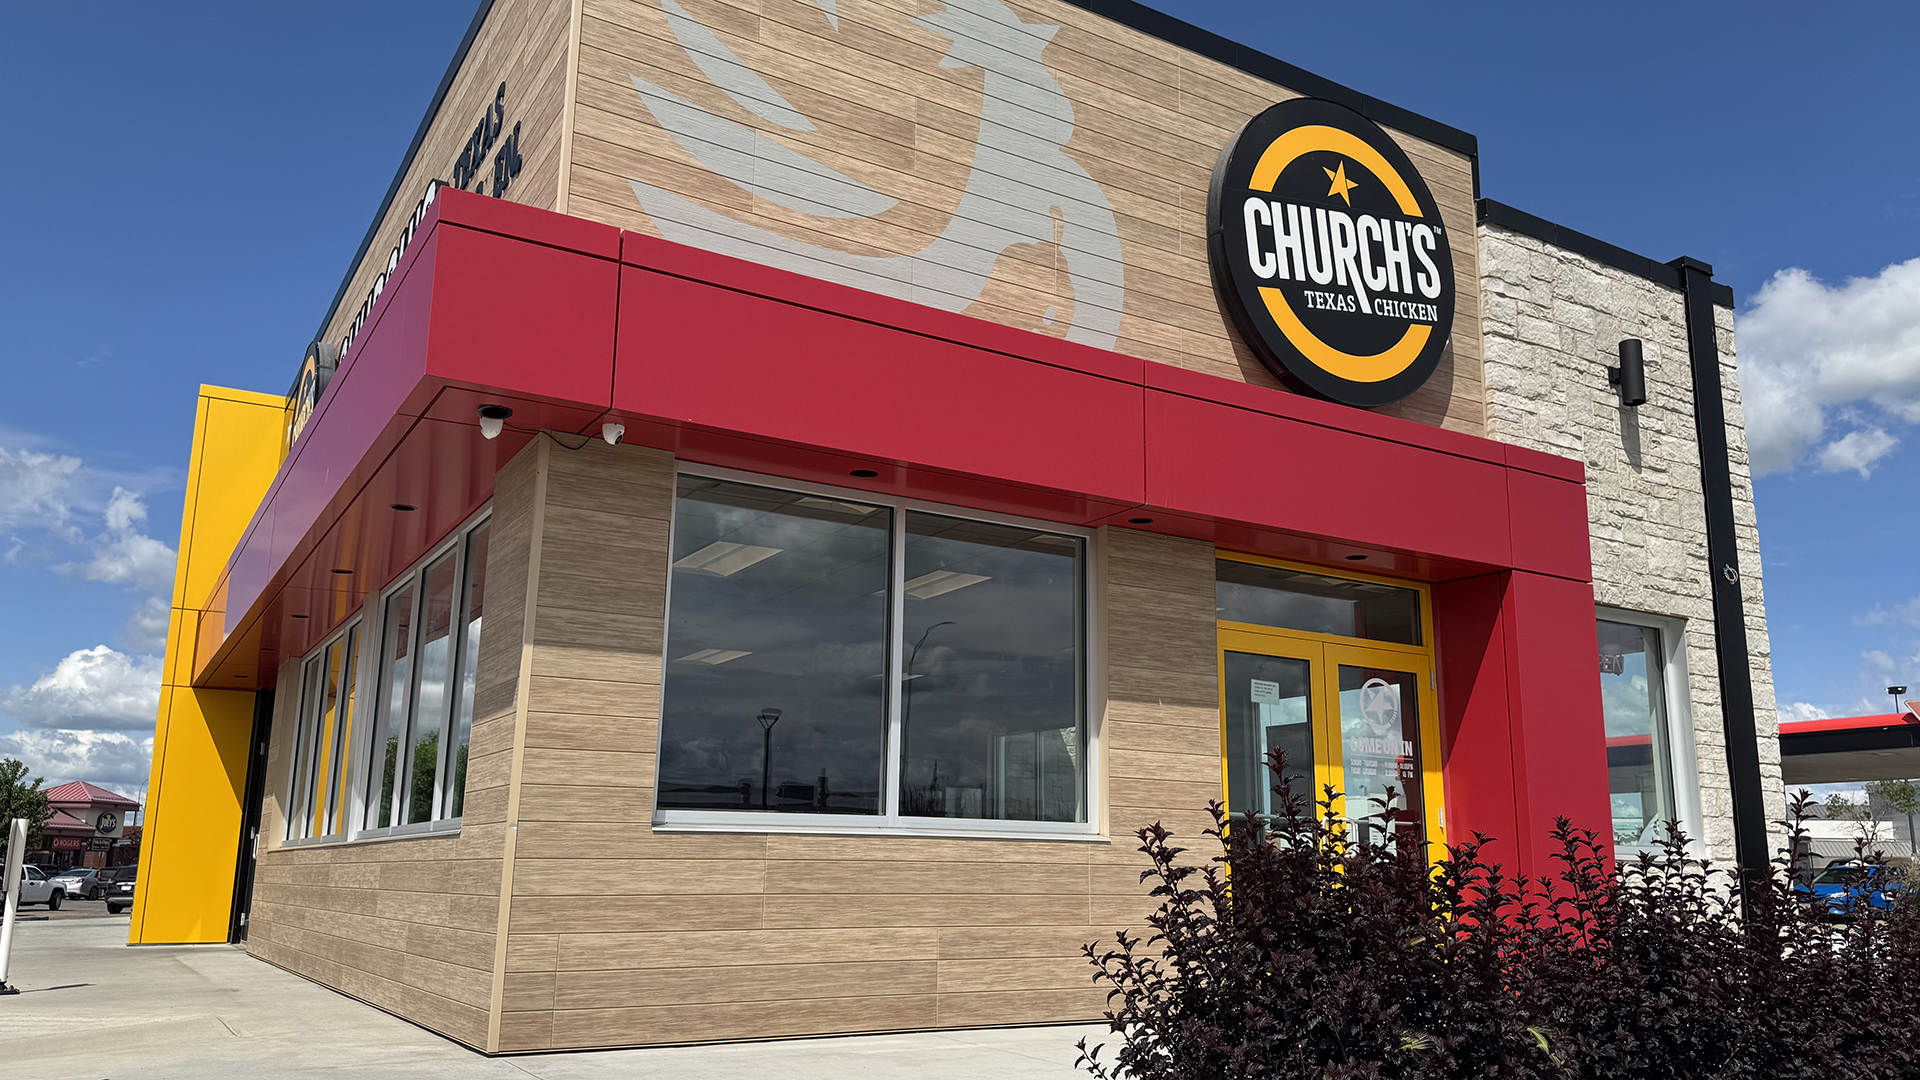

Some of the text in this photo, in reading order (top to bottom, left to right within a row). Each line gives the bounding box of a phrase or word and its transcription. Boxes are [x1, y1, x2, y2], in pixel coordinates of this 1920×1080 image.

[1243, 196, 1442, 314] CHURCH'S
[1304, 290, 1357, 313] TEXAS
[1374, 298, 1438, 322] CHICKEN
[1350, 736, 1413, 757] COME ON IN
[59, 839, 80, 847] ROGERS
